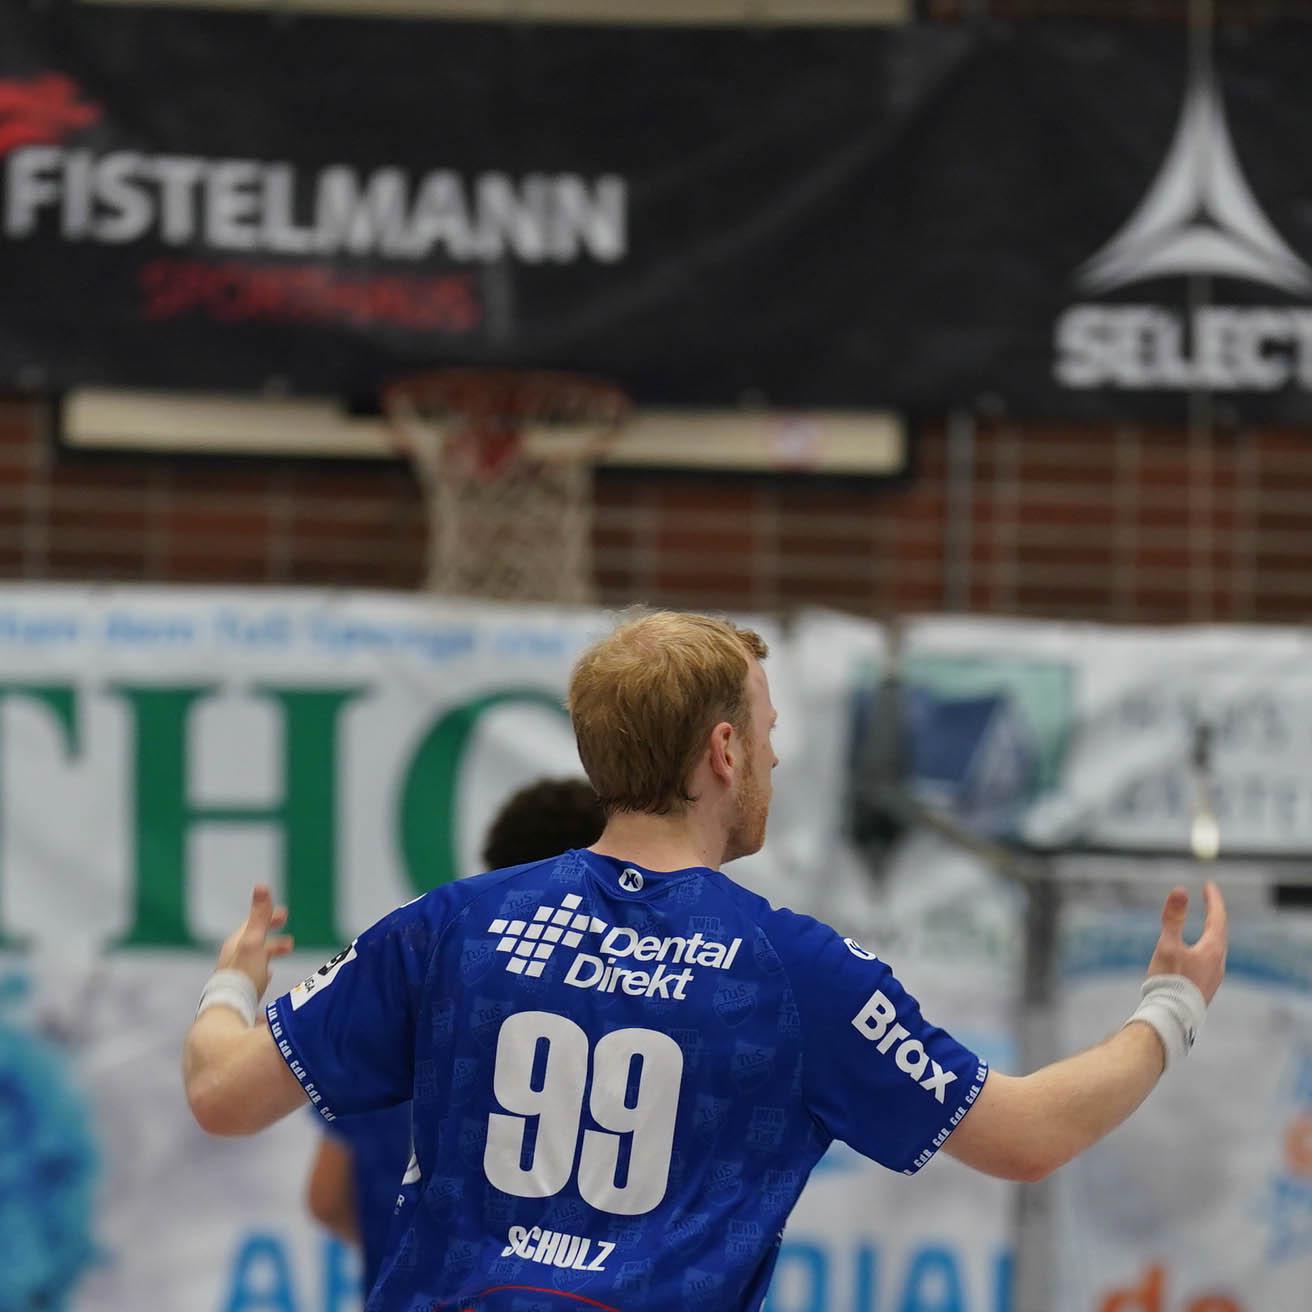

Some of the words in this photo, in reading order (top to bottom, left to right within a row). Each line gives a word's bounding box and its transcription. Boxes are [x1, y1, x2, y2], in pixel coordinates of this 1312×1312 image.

[4, 144, 626, 261] FISTELMANN
[563, 952, 694, 1000] Direkt
[599, 926, 744, 970] Dental
[850, 988, 958, 1104] Brax
[483, 1010, 684, 1216] 99
[501, 1225, 616, 1272] SCHULZ
